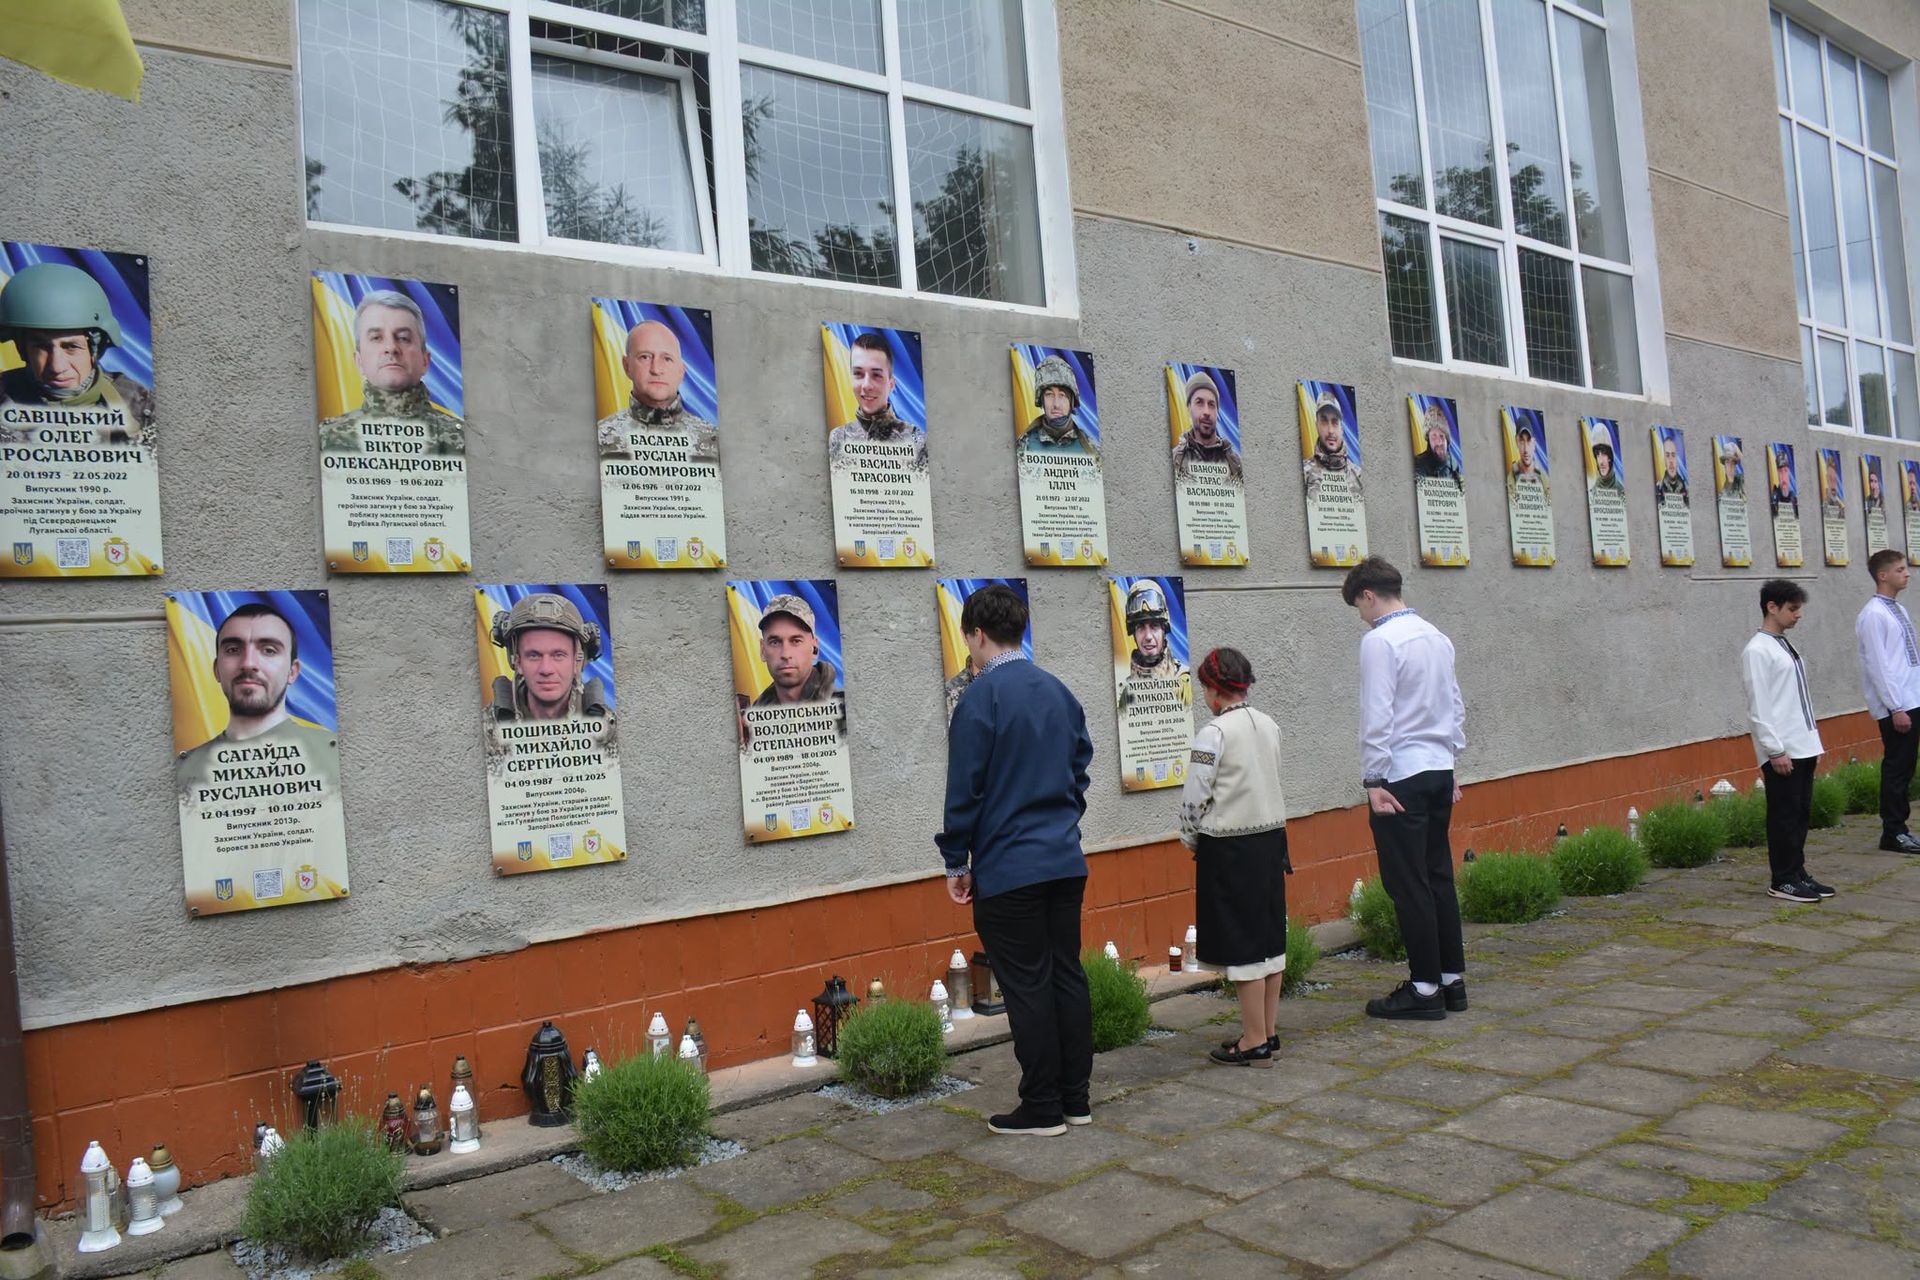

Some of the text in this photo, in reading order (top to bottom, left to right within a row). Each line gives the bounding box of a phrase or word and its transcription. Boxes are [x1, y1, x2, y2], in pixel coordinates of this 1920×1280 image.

[4, 409, 125, 426] САВІЦЬКИЙ
[361, 423, 424, 437] ПЕТРОВ
[39, 430, 93, 444] ОЛЕГ
[630, 434, 689, 447] БАСАРАБ
[364, 441, 423, 454] ВІКТОР
[844, 444, 914, 456] СКОРЕЦЬКИЙ
[0, 448, 143, 463] РОСЛАВОВИЧ
[634, 450, 686, 462] РУСЛАН
[1026, 455, 1093, 467] ВОЛОШИНЮК
[324, 456, 463, 472] ОЛЕКСАНДРОВИЧ
[860, 459, 901, 470] ВАСИЛЬ
[1190, 465, 1228, 474] ІВАНОЧКО
[6, 471, 127, 480] 20.01.1973 22.05.2022
[605, 465, 716, 478] ЛЮБОМИРОВИЧ
[1043, 468, 1079, 478] АНДРІЙ
[346, 478, 443, 487] 05.03.1969 19.06.2022
[850, 472, 911, 484] ТАРАСОВИЧ
[1199, 477, 1221, 485] ТАРАС
[25, 485, 76, 494] Випускник
[1049, 481, 1076, 491] ІЛЛІЧ
[1322, 484, 1348, 492] СТЕПАН
[1186, 488, 1235, 497] ВАСИЛЬОВИЧ
[1319, 495, 1352, 503] ІВАНОВИЧ
[0, 508, 34, 516] ероїчно
[23, 517, 37, 525] під
[381, 520, 418, 528] Луганської
[29, 527, 77, 535] Луганської
[1129, 679, 1180, 691] МИХАЙЛЮК
[1137, 692, 1174, 703] МИКОЛА
[747, 702, 838, 722] СКОРУПСЬКИЙ
[1129, 703, 1183, 717] ДМИТРОВИЧ
[502, 720, 602, 739] ПОШИВАЙЛО
[754, 720, 833, 737] ВОЛОДИМИР
[515, 737, 591, 755] МИХАЙЛО
[753, 734, 836, 752] СТЕПАНОВИЧ
[218, 743, 300, 764] САГАЙДА
[507, 754, 602, 773] СЕРГІЙОВИЧ
[771, 764, 800, 772] Випускник
[212, 760, 306, 782] МИХАЙЛО
[504, 773, 606, 789] 04.09.1987 02.11.2025
[198, 779, 322, 802] РУСЛАНОВИЧ
[525, 789, 562, 799] Випускник
[200, 801, 322, 820] 12.04.1997 10.10.2025
[501, 803, 532, 811] Захисник
[561, 798, 588, 806] старший
[559, 805, 583, 813] Україну
[227, 817, 300, 830] Випускник 2013р.
[497, 809, 618, 827] міста Гуляйполе Пологівського району
[528, 822, 565, 831] Запорізької
[214, 834, 252, 844] Захисник
[217, 844, 248, 853] боровся
